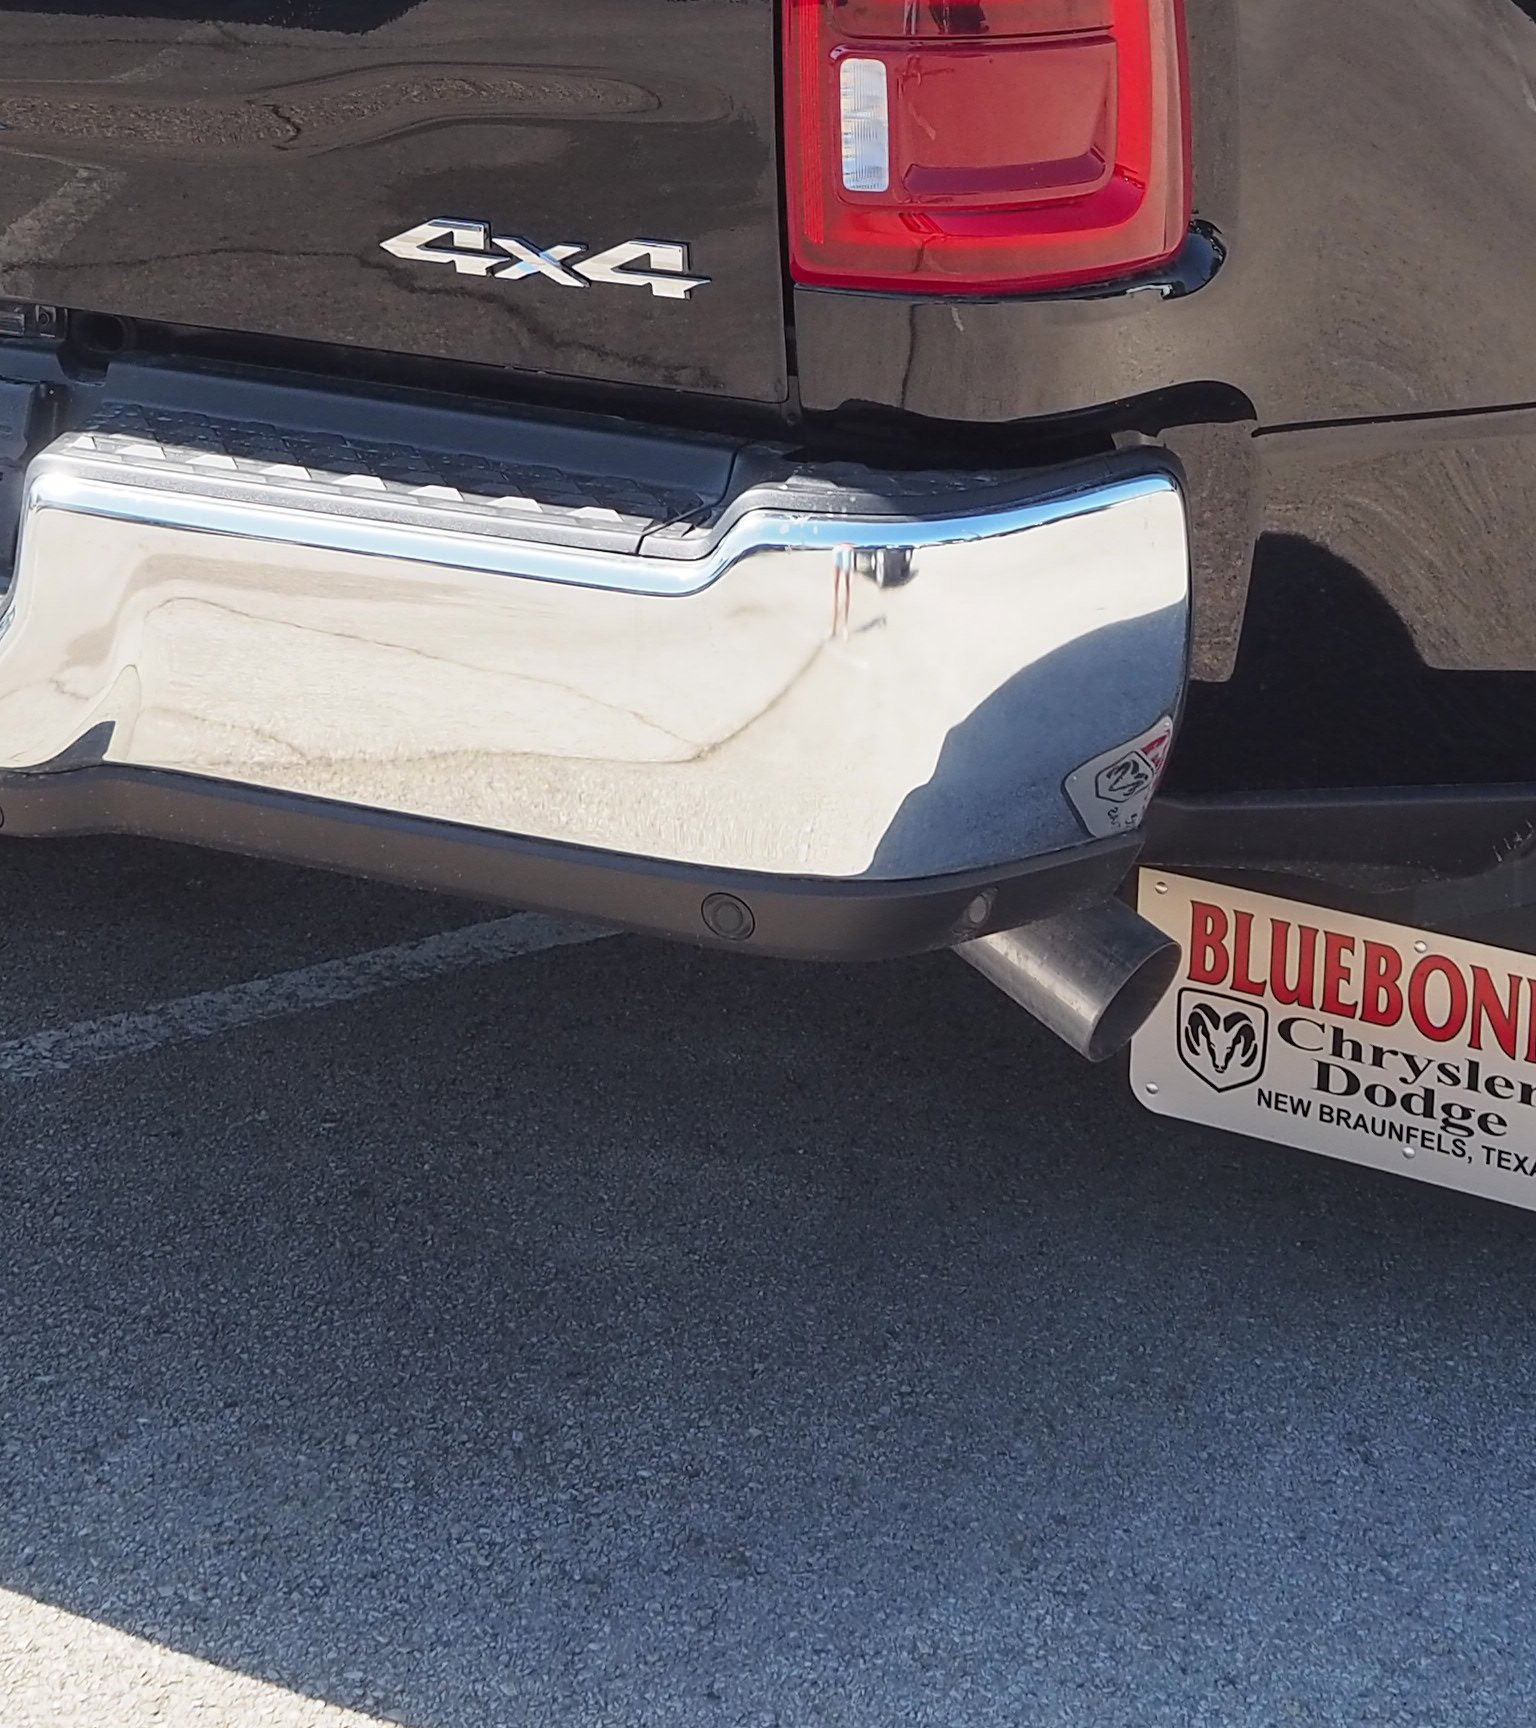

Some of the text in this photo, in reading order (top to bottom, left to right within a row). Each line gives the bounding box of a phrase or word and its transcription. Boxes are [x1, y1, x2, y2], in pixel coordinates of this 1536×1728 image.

[1256, 1087, 1313, 1120] NEW
[1317, 1103, 1475, 1165] BRAUNFELS,
[1312, 1058, 1510, 1139] Dodge
